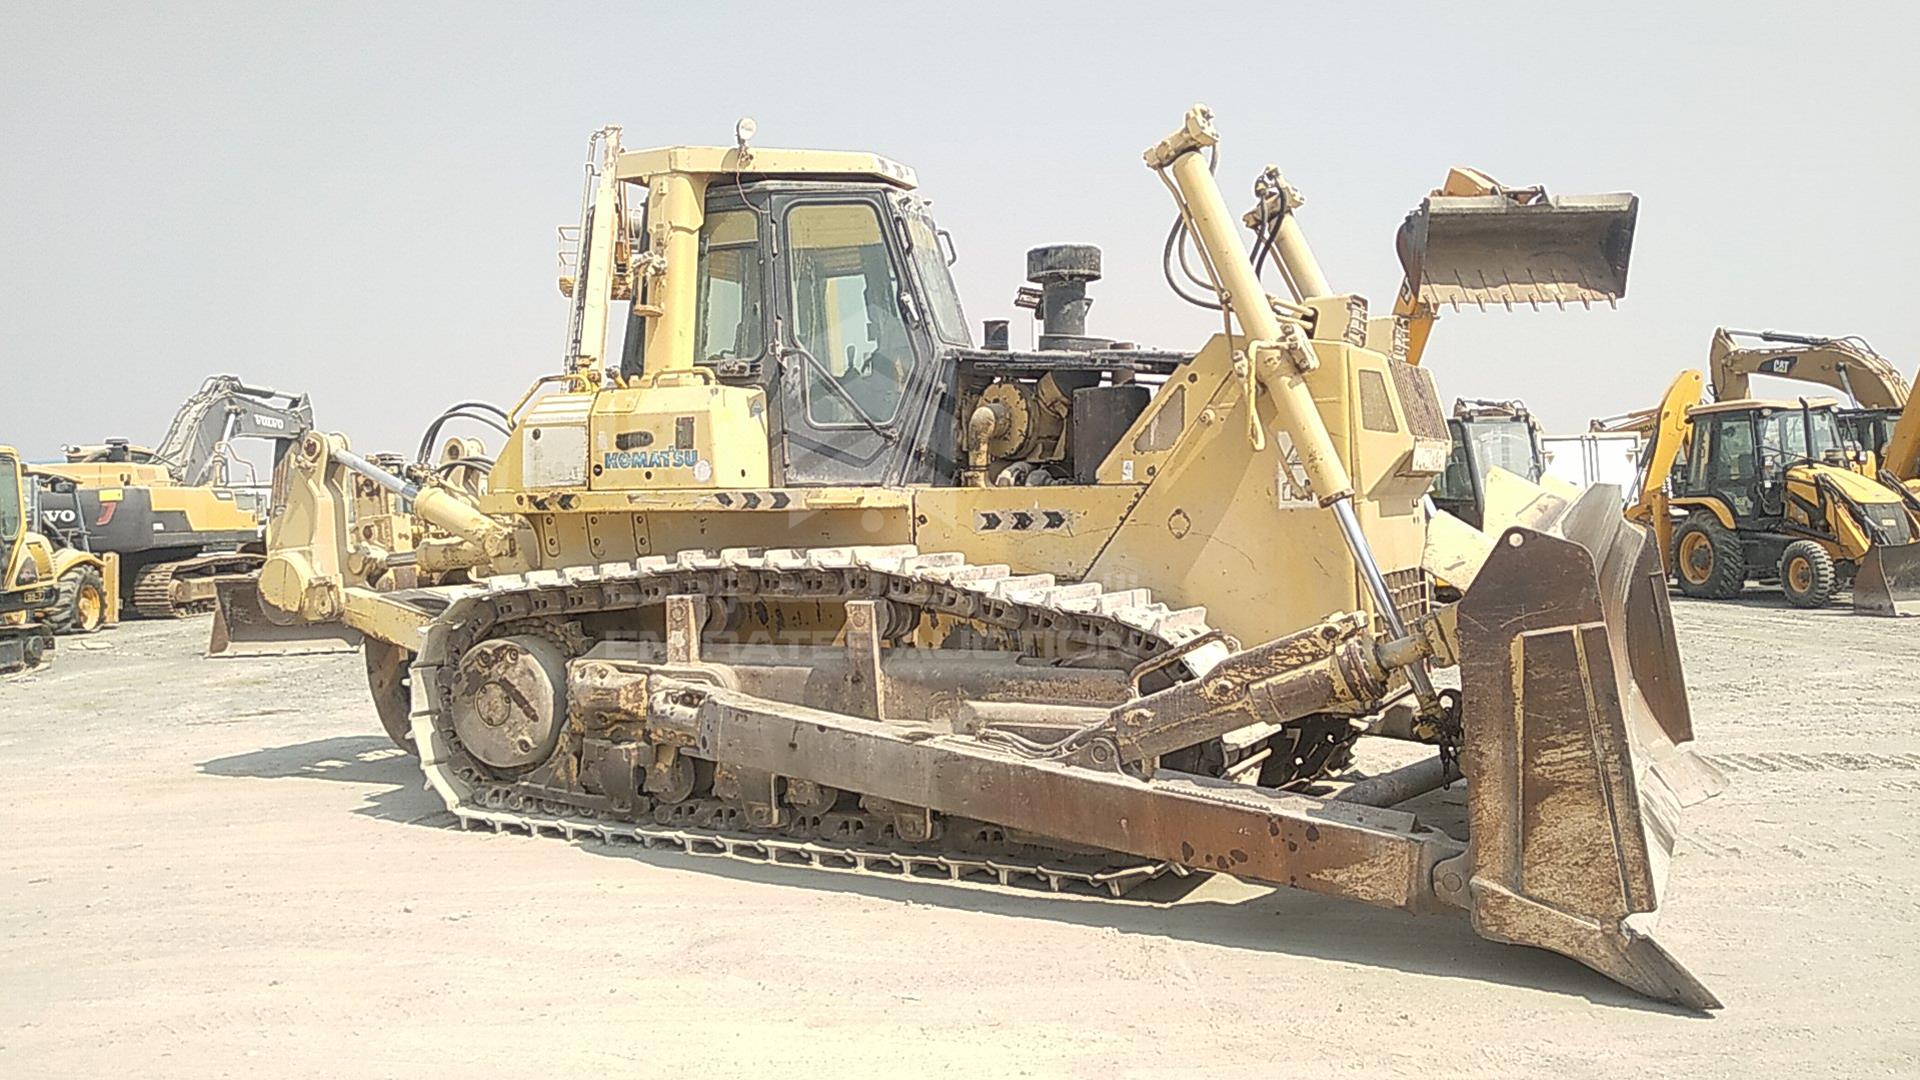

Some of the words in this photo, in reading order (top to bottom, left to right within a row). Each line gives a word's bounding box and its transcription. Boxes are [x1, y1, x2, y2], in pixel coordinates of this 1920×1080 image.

[1773, 359, 1790, 373] CAT
[253, 413, 284, 430] VOLVO
[604, 449, 698, 469] KOMATSU
